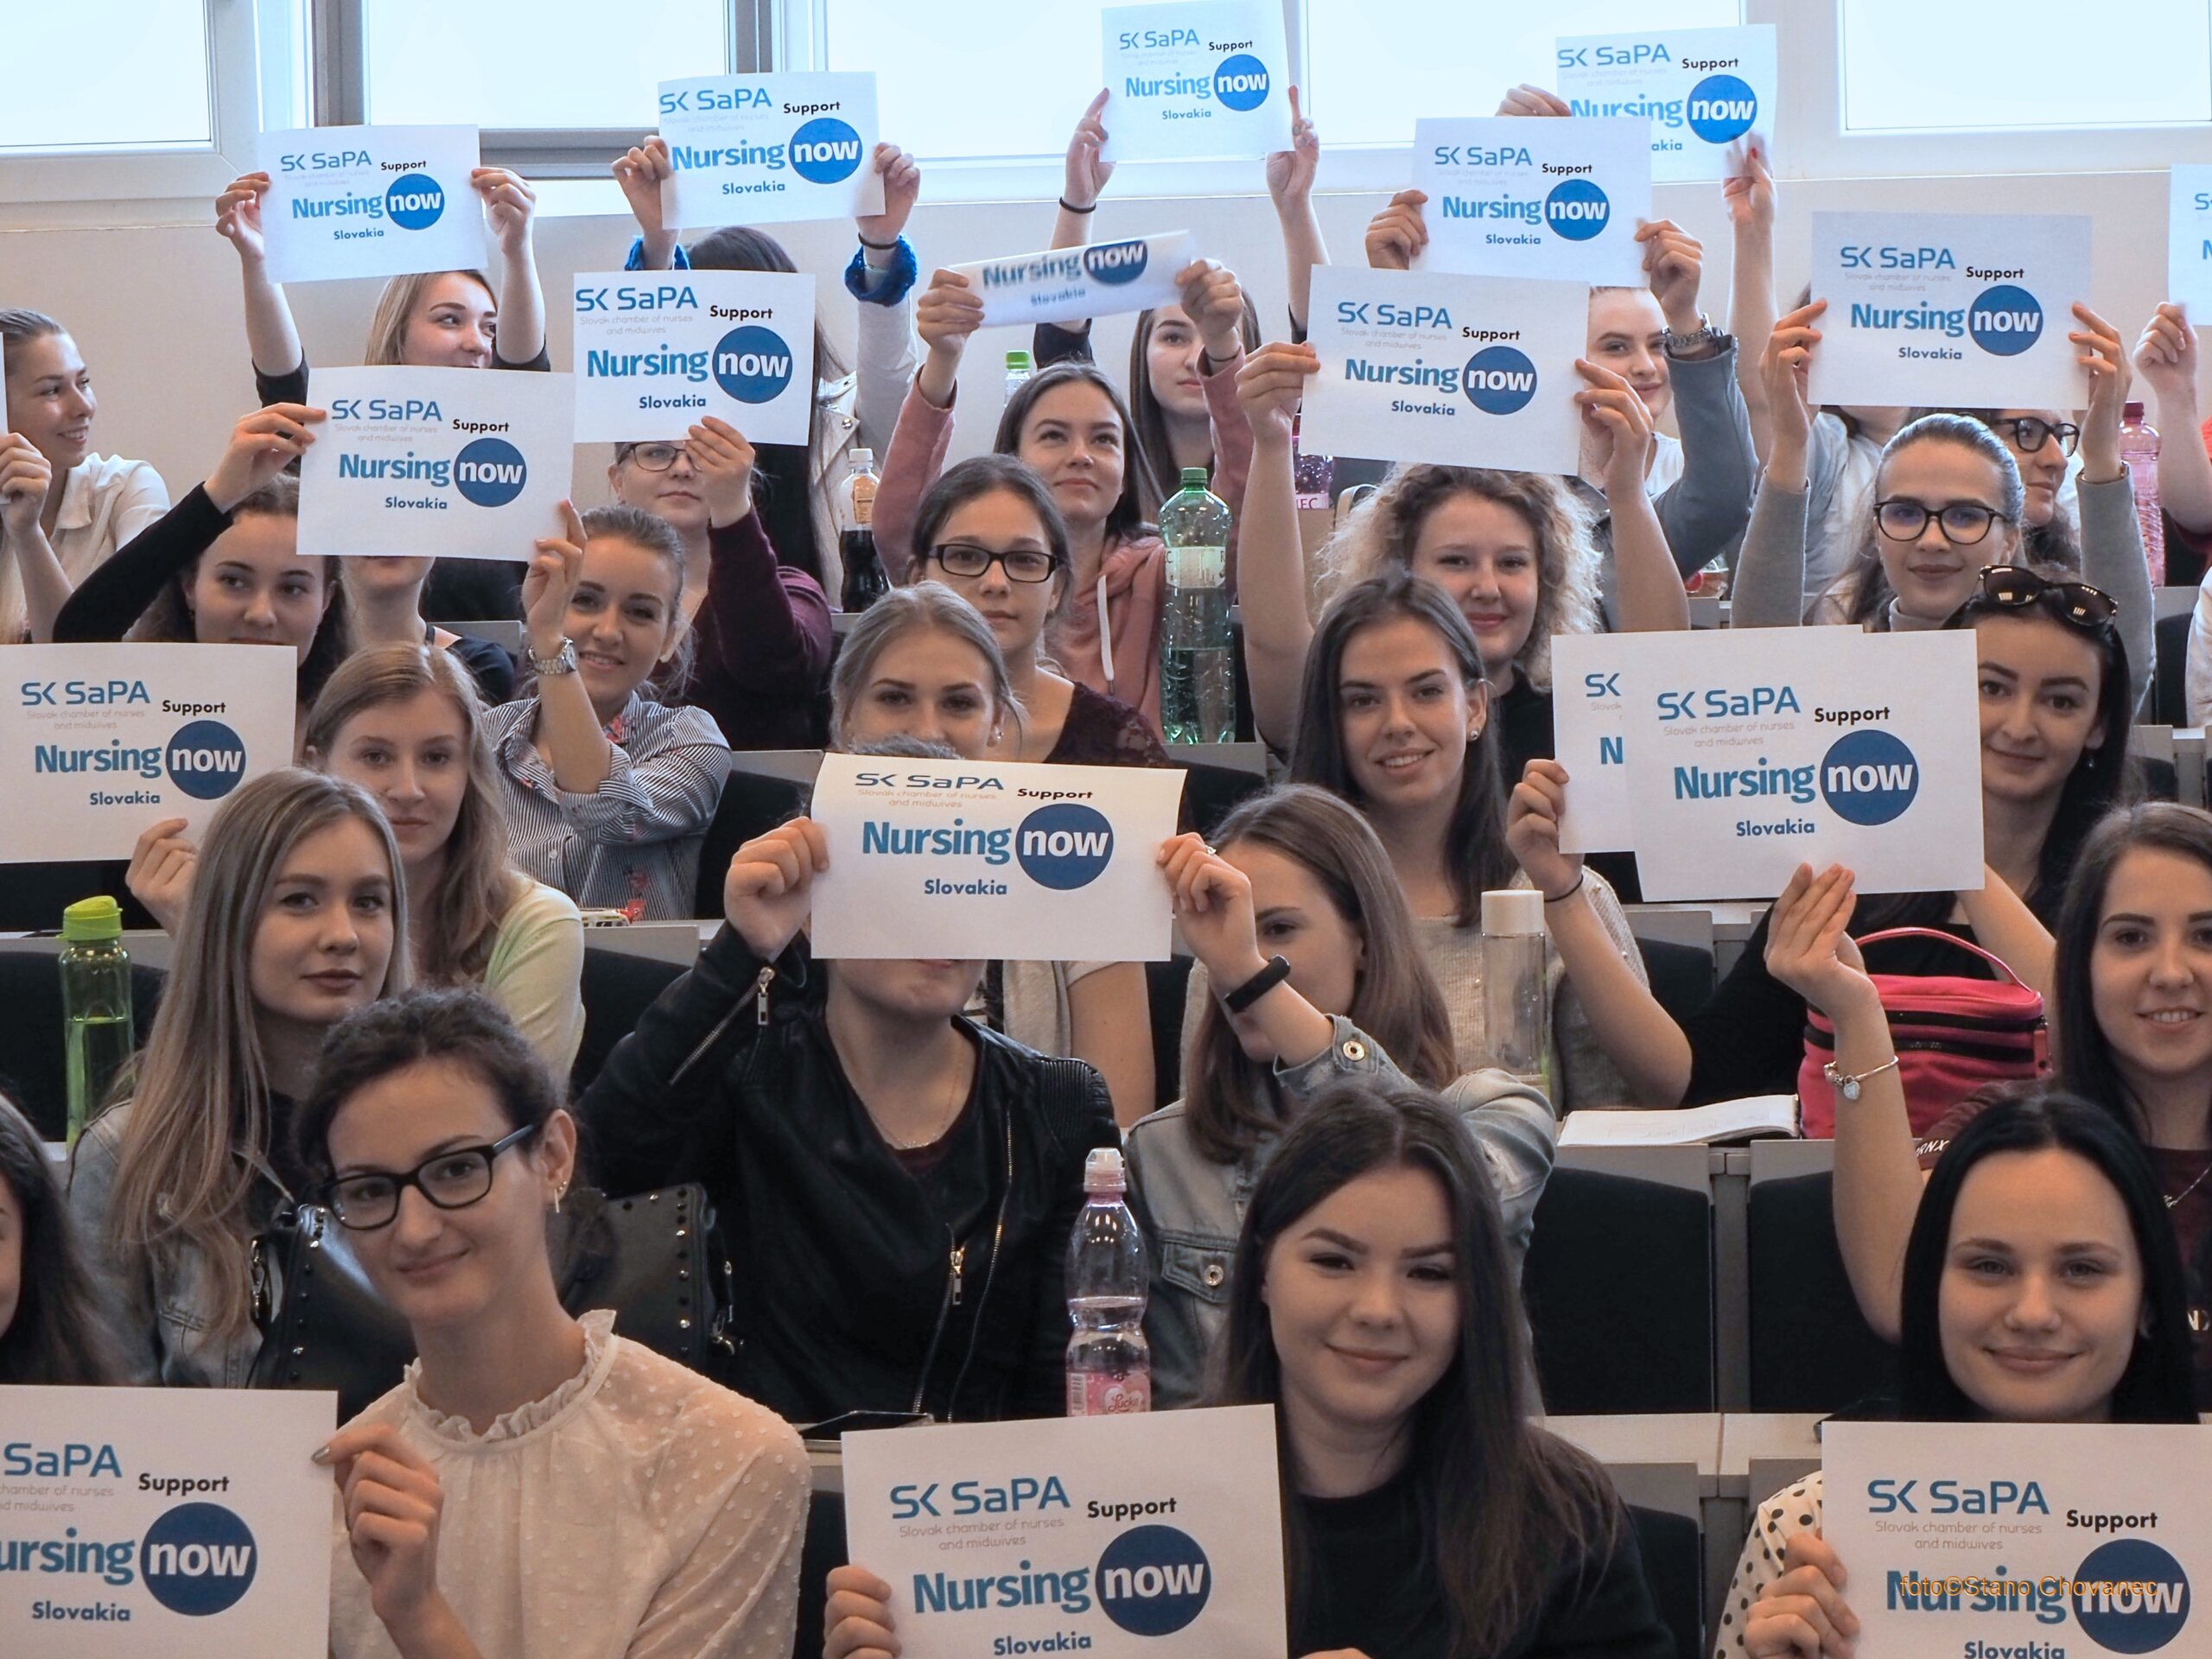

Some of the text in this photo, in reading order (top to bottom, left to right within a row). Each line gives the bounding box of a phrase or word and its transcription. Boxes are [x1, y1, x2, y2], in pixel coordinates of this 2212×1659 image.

[1120, 29, 1199, 49] SK SaPA
[1209, 41, 1252, 52] Support
[1558, 44, 1670, 67] SK SaPA
[1682, 59, 1738, 71] Support
[1126, 72, 1267, 99] Nursing now
[660, 88, 772, 113] SK SaPA
[784, 102, 840, 116] Support
[1570, 93, 1754, 128] Nursing now
[1162, 108, 1211, 119] Slovakia
[672, 139, 858, 170] Nursing now
[1652, 140, 1682, 151] akia
[281, 150, 372, 171] SK SaPA
[381, 161, 426, 172] Support
[1434, 147, 1532, 166] SK SaPA
[1542, 163, 1592, 175] Support
[722, 181, 785, 194] Slovakia
[292, 192, 441, 219] Nursing now
[1443, 194, 1606, 226] Nursing now
[334, 228, 384, 239] Slovakia
[1486, 234, 1541, 245] Slovakia
[982, 242, 1143, 288] Nursing now
[1840, 247, 1955, 270] SK SaPA
[1967, 267, 2024, 281] Support
[575, 286, 697, 311] SK SaPA
[710, 306, 772, 321] Support
[1338, 302, 1452, 328] SK SaPA
[1851, 301, 2039, 337] Nursing now
[1462, 327, 1520, 342] Support
[588, 344, 789, 382] Nursing now
[1898, 347, 1962, 359] Slovakia
[1345, 359, 1533, 393] Nursing now
[332, 400, 442, 421] SK SaPA
[639, 395, 706, 409] Slovakia
[1392, 401, 1455, 416] Slovakia
[453, 419, 509, 434] Support
[339, 452, 523, 487] Nursing now
[385, 497, 448, 510] Slovakia
[22, 681, 150, 706] SK SaPA
[1585, 673, 1620, 697] SK
[162, 700, 226, 715] Support
[1657, 686, 1801, 721] SK SaPA
[1815, 707, 1890, 726] Support
[1664, 721, 1795, 737] Slovak chamber of nurses
[1694, 734, 1764, 748] and midwives
[35, 739, 241, 779] Nursing now
[855, 773, 1004, 791] SK SaPA
[1675, 757, 1913, 804] Nursing now
[90, 791, 160, 805] Slovakia
[912, 799, 962, 808] midwives
[1017, 788, 1093, 800] Support
[1736, 818, 1815, 836] Slovakia
[862, 818, 1109, 865] Nursing now
[925, 879, 1007, 895] Slovakia
[3, 1443, 122, 1478] SaPA
[54, 1484, 67, 1496] of
[72, 1486, 114, 1497] nurses
[138, 1473, 230, 1497] Support
[15, 1501, 75, 1512] midwives
[890, 1476, 1071, 1519] SK SaPA
[1867, 1479, 2050, 1515] SK SaPA
[1087, 1497, 1177, 1521] Support
[899, 1517, 1065, 1537] Slovak chamber of nurses
[1876, 1522, 2042, 1534] Slovak chamber of nurses
[2067, 1510, 2158, 1532] Support
[939, 1535, 1027, 1551] and midwives
[1915, 1538, 2003, 1550] and midwives
[0, 1528, 251, 1586] ursing now
[913, 1560, 1204, 1614] Nursing now
[1887, 1565, 2183, 1624] Nursing now
[32, 1601, 130, 1621] Slovakia
[994, 1631, 1092, 1656] Slovakia
[1964, 1641, 2065, 1659] Slovakia
